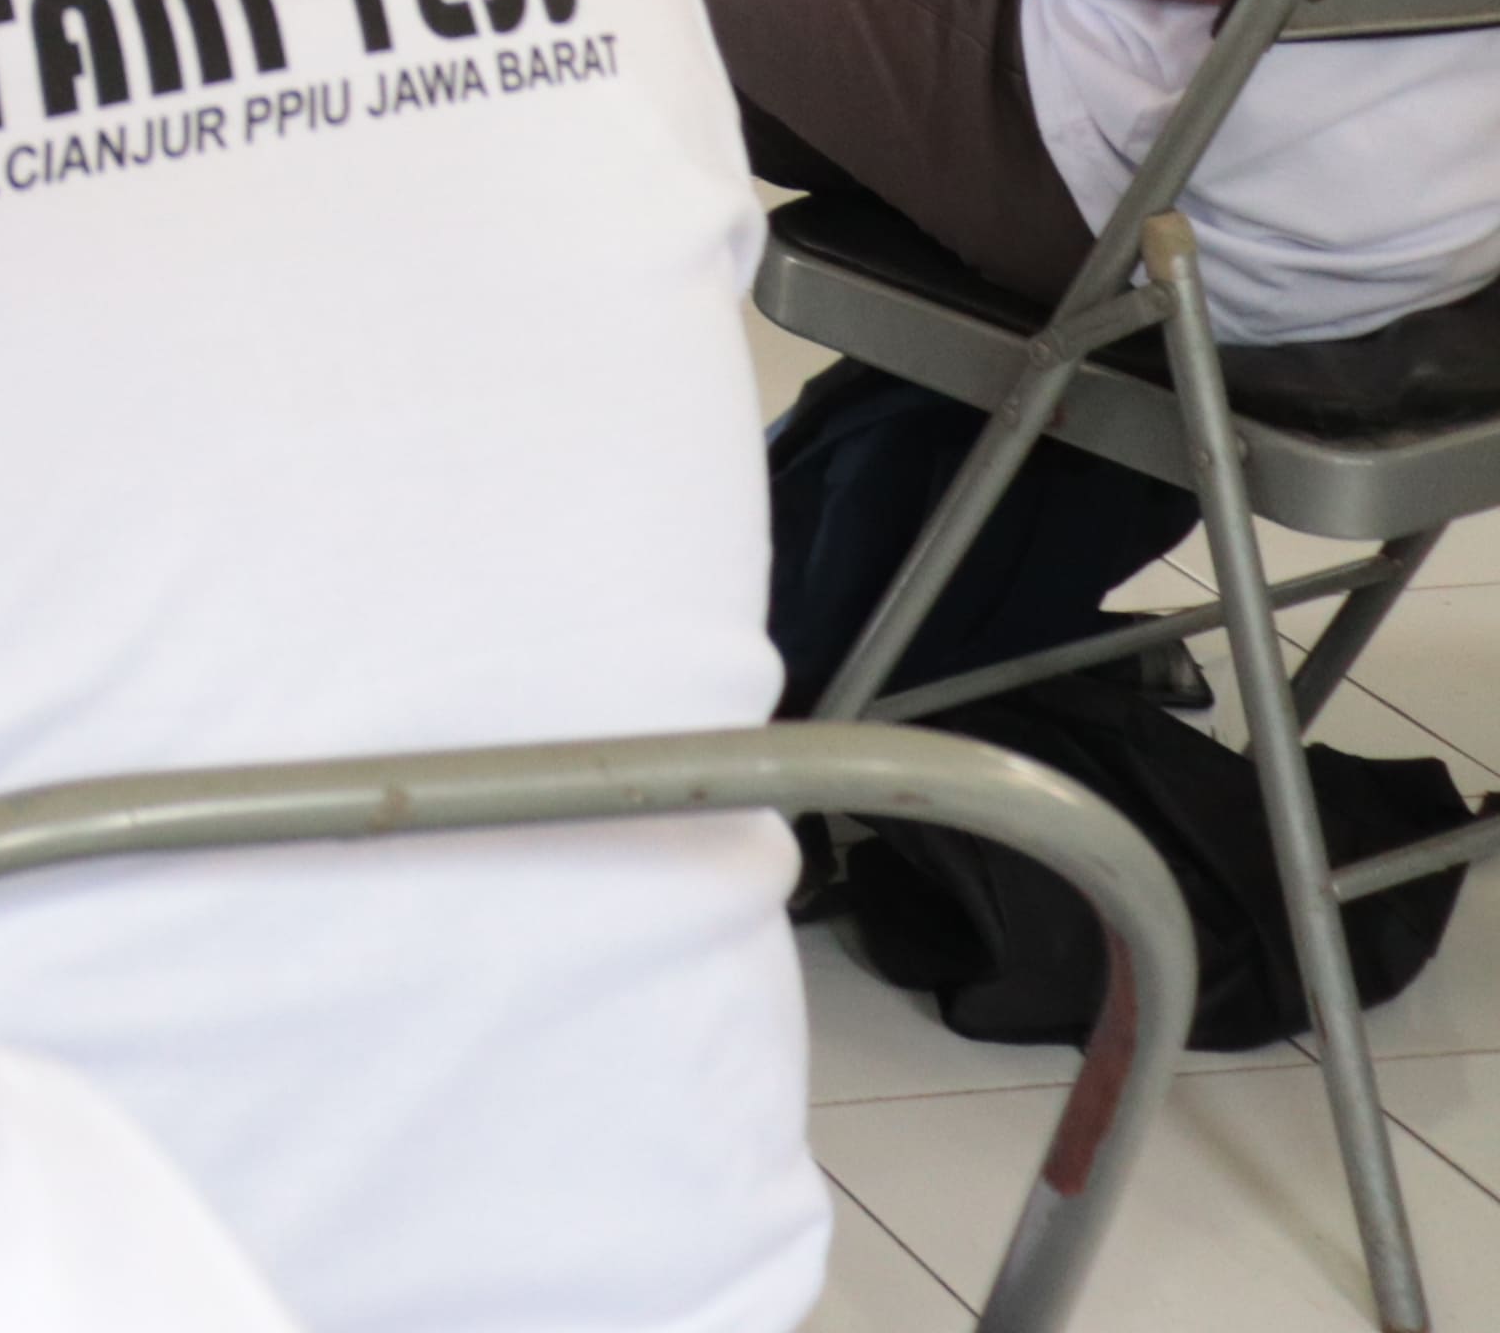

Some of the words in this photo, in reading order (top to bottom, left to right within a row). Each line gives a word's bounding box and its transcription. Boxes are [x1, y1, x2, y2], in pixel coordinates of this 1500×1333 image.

[242, 77, 355, 145] PPIU
[367, 62, 489, 119] JAWA
[499, 33, 620, 95] BARAT
